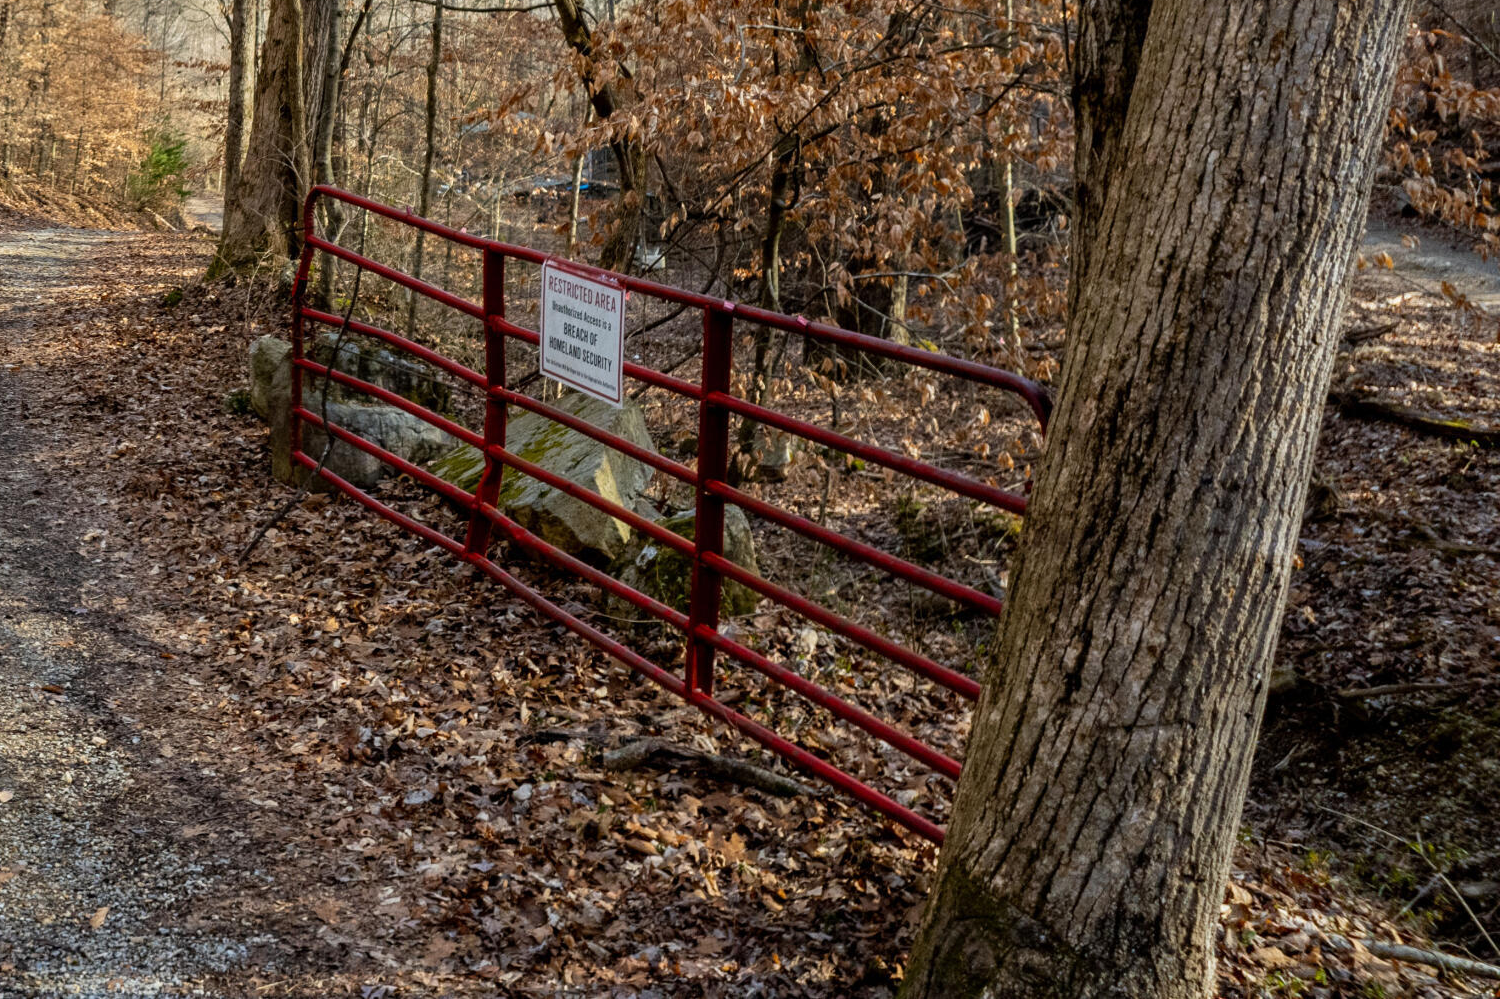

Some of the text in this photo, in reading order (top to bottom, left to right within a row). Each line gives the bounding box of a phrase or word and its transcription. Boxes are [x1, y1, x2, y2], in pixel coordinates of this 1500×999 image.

[548, 275, 616, 313] RESTRICTED AREA
[552, 300, 583, 320] Unauthorized
[584, 311, 601, 328] Access
[563, 322, 598, 346] BREACH OF
[549, 336, 613, 372] HOMELAND SECURITY
